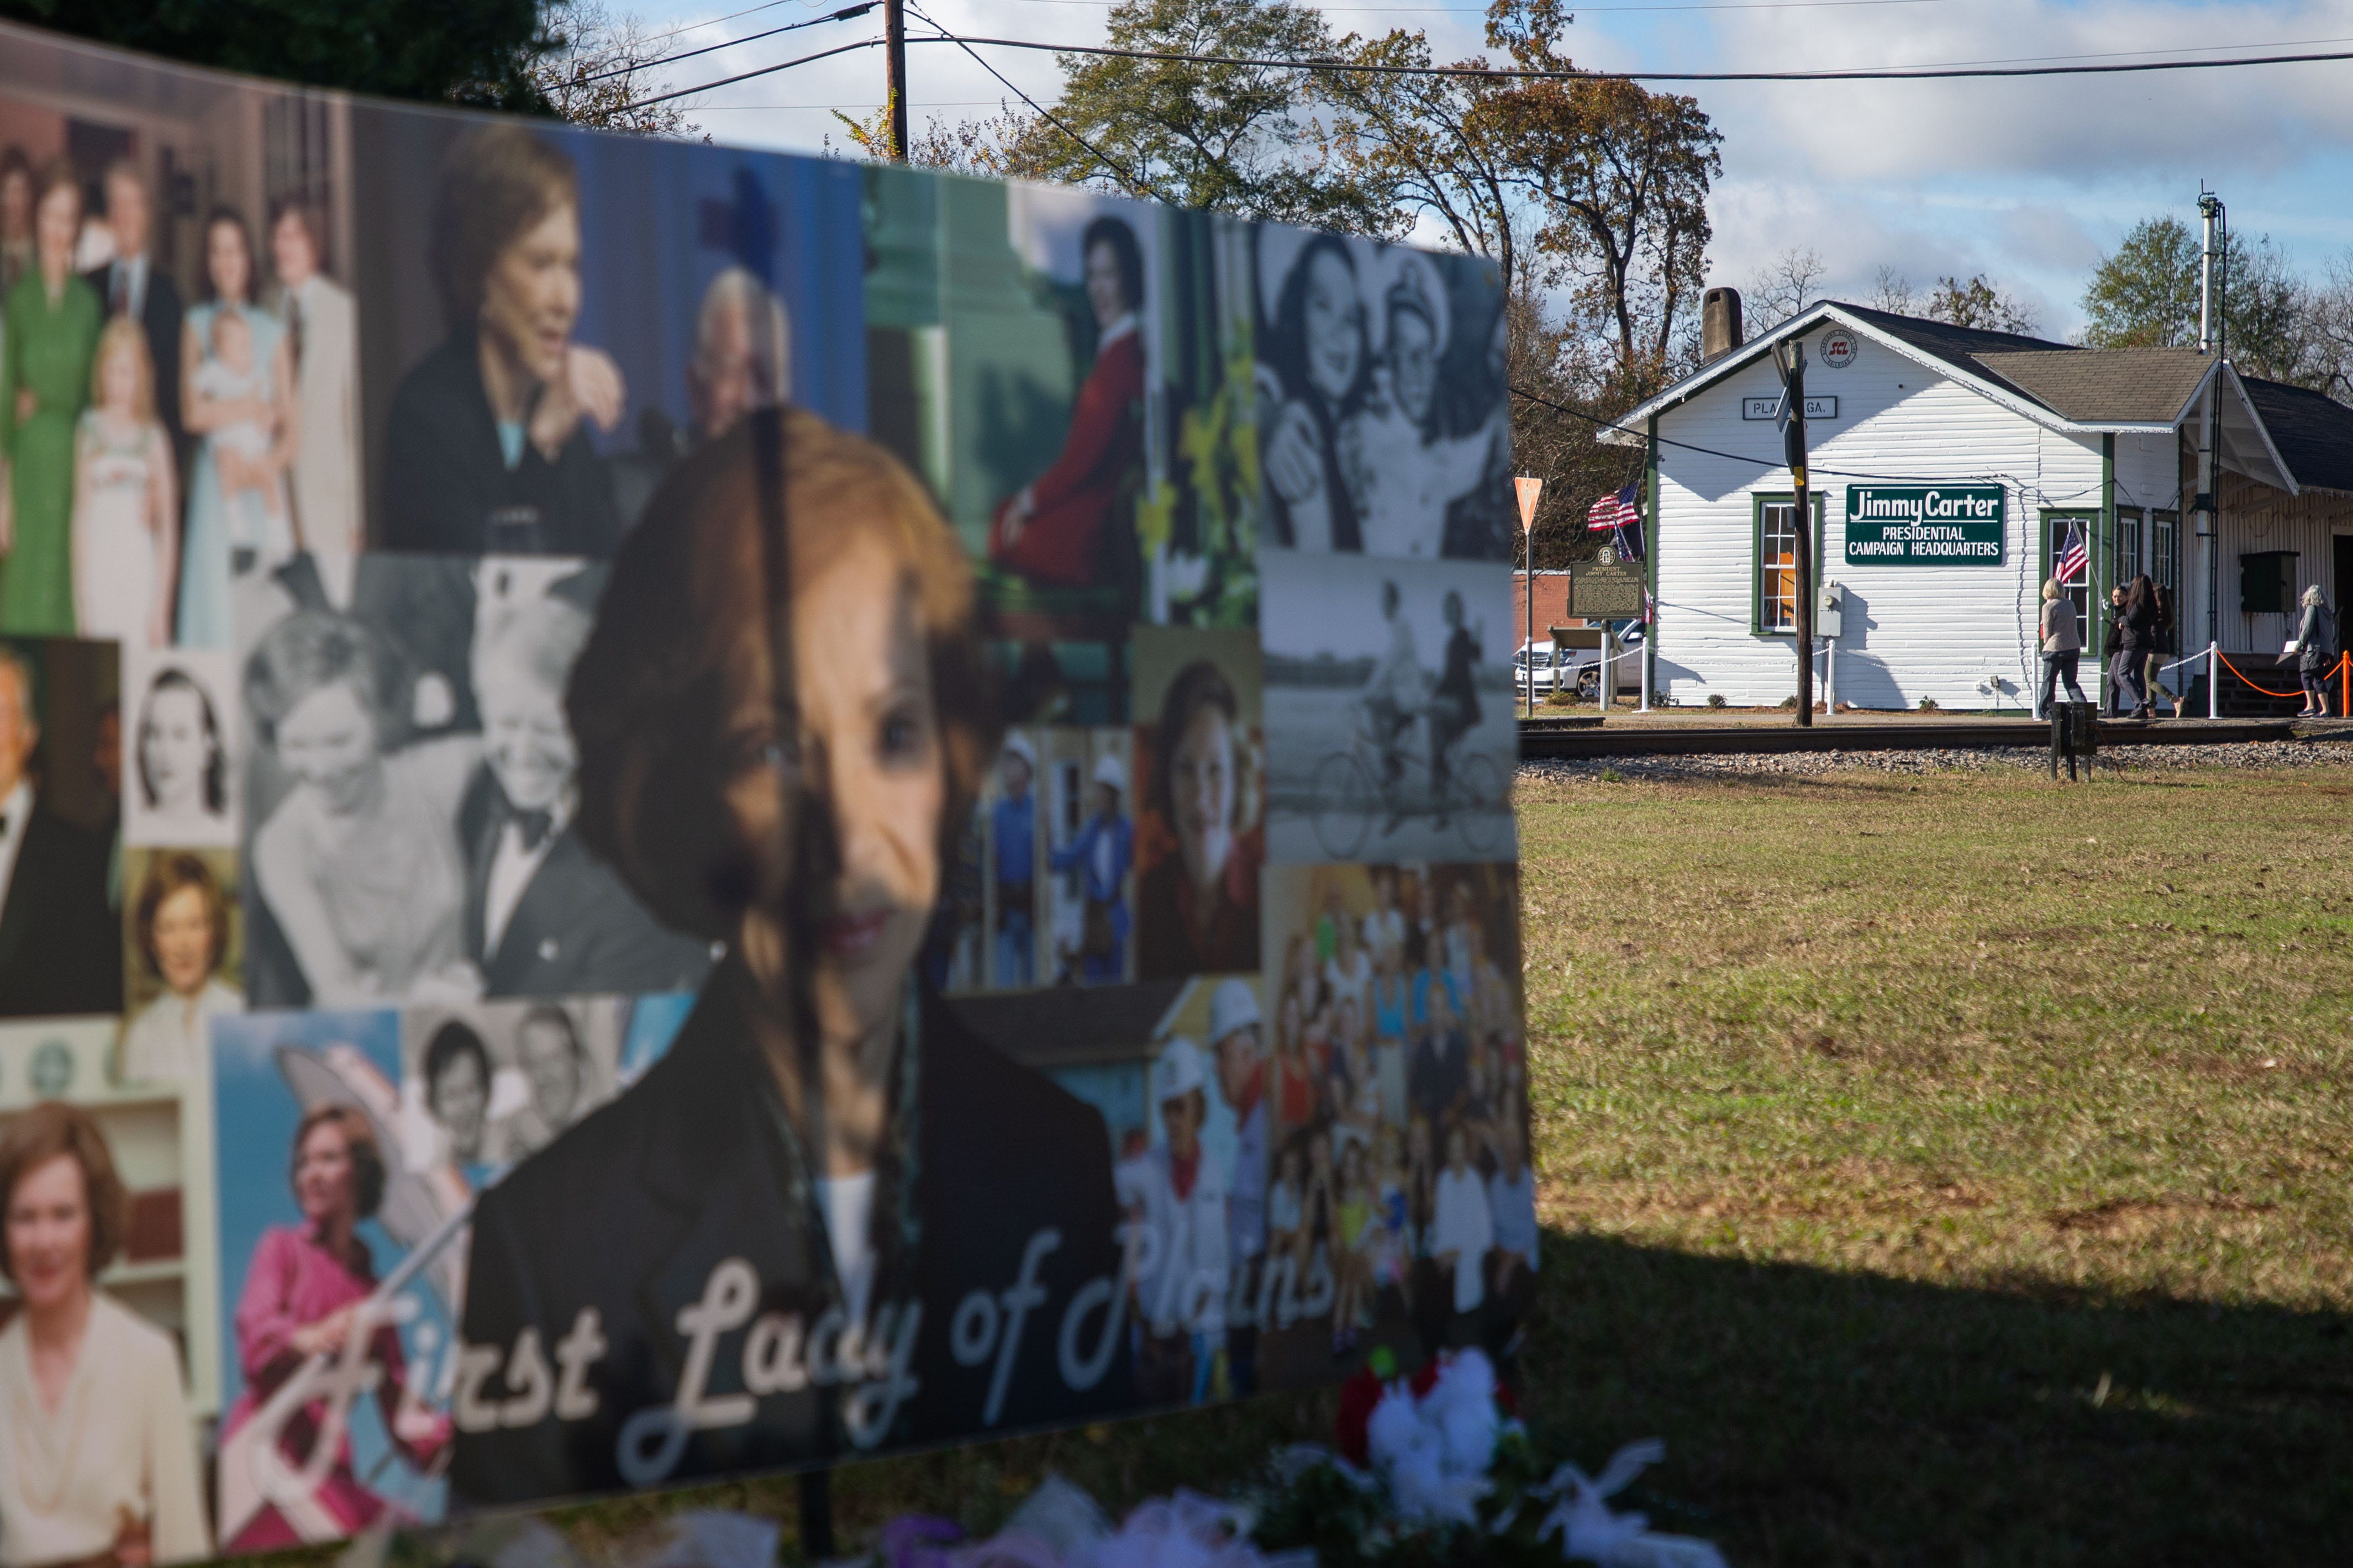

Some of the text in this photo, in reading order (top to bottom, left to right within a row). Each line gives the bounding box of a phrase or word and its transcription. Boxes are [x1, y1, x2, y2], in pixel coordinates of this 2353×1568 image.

[1829, 341, 1849, 356] SCL
[1827, 359, 1850, 367] RAILROAD
[1807, 402, 1825, 413] GA.
[1850, 490, 1999, 527] Jimmy Carter
[1883, 526, 1966, 541] PRESIDENTIAL
[1849, 541, 1999, 556] CAMPAIGN HEADQUARTERS
[246, 1219, 1334, 1500] First Lady of Plains
